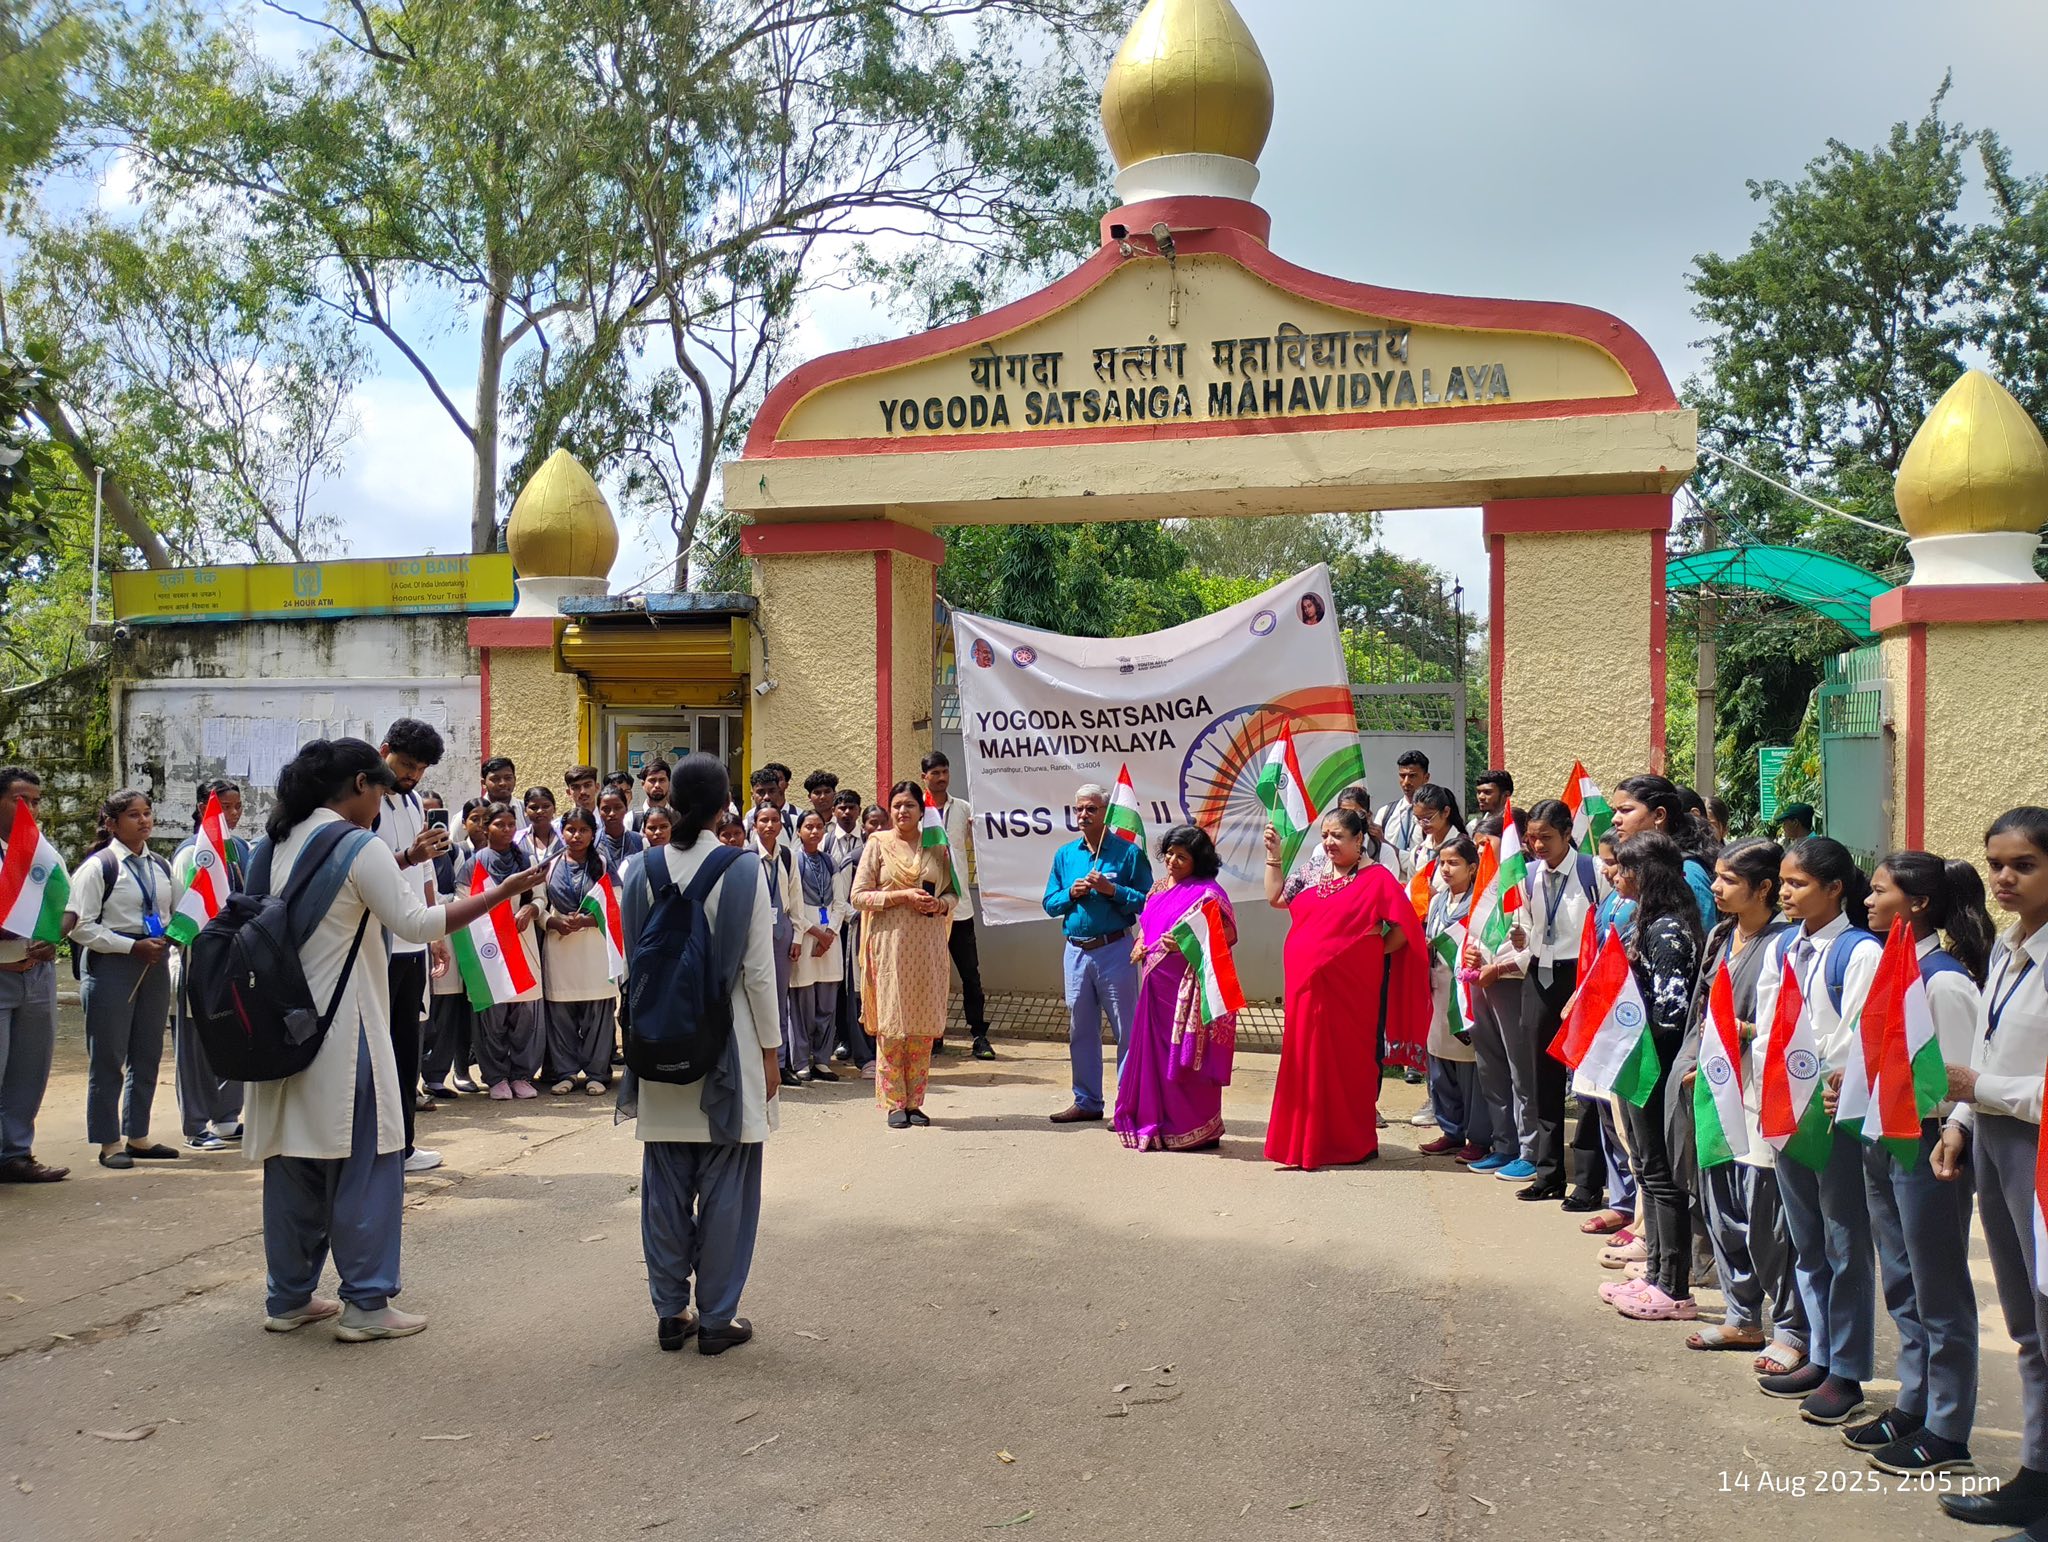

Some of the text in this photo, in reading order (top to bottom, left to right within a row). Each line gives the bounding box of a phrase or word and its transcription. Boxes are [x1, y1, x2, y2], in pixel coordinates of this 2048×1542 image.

[969, 322, 1411, 391] योगदा सत्संग महाविद्यालय
[879, 363, 1510, 433] YOGODA SATSANGA MAHAVIDYALAYA
[388, 559, 470, 576] UCO BANK
[294, 599, 315, 607] HOUR
[976, 695, 1213, 732] YOGODA SATSANGA
[979, 728, 1176, 759] MAHAVIDYALAYA
[1076, 761, 1101, 769] 834004
[985, 807, 1053, 840] NSS
[1151, 801, 1172, 824] II
